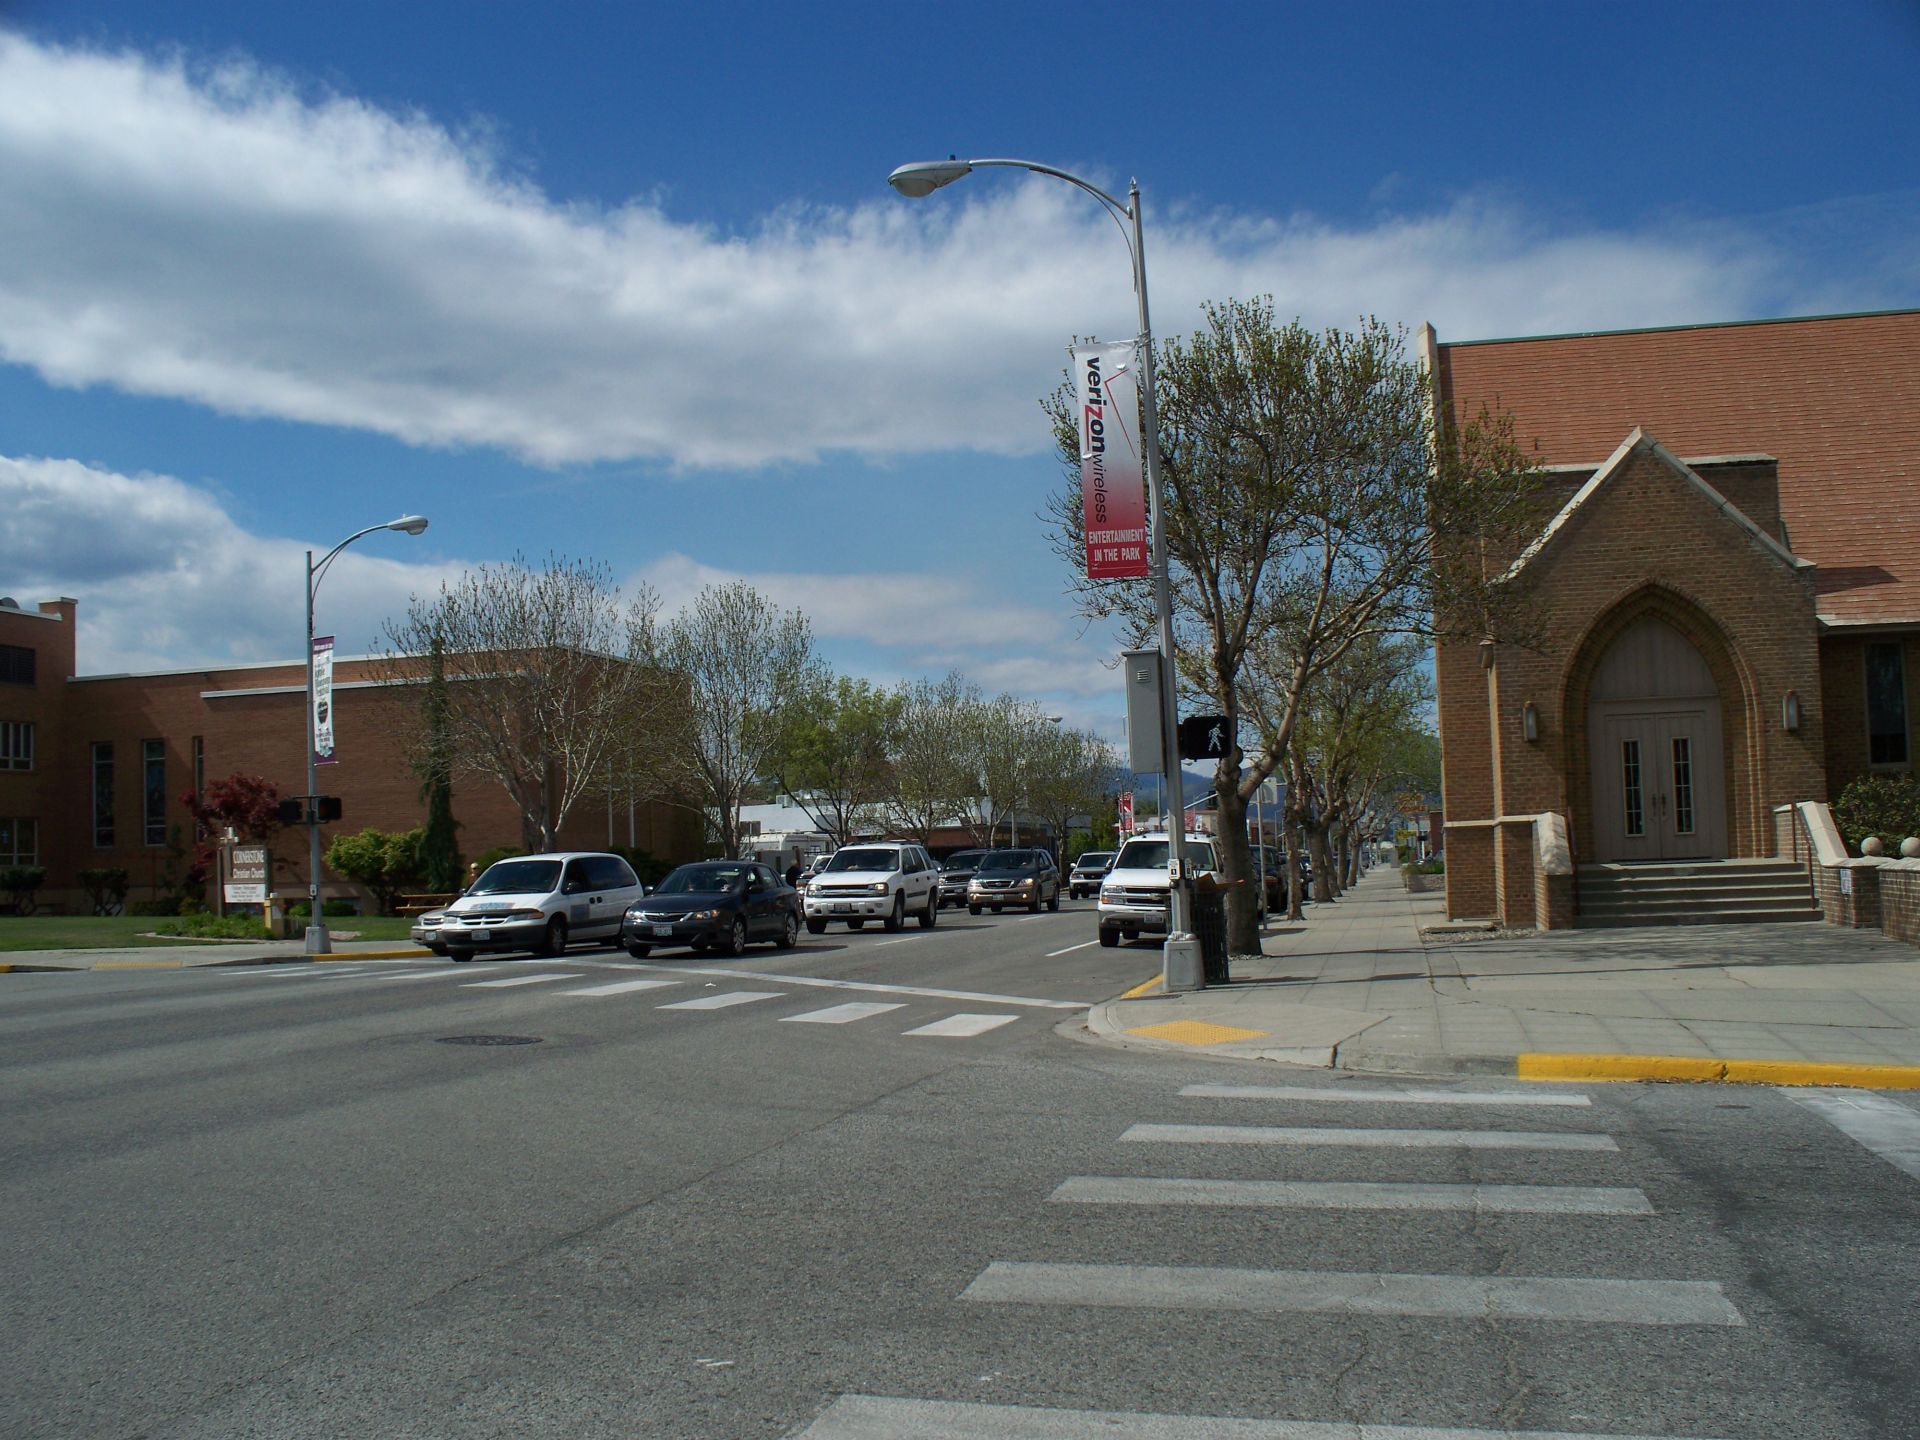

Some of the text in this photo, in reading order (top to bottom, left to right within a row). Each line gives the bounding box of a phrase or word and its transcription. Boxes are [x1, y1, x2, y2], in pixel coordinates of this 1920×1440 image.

[1085, 357, 1108, 523] verizon wireless
[1088, 529, 1144, 544] ENTERTAINMENT
[1094, 547, 1141, 562] IN THE PARK
